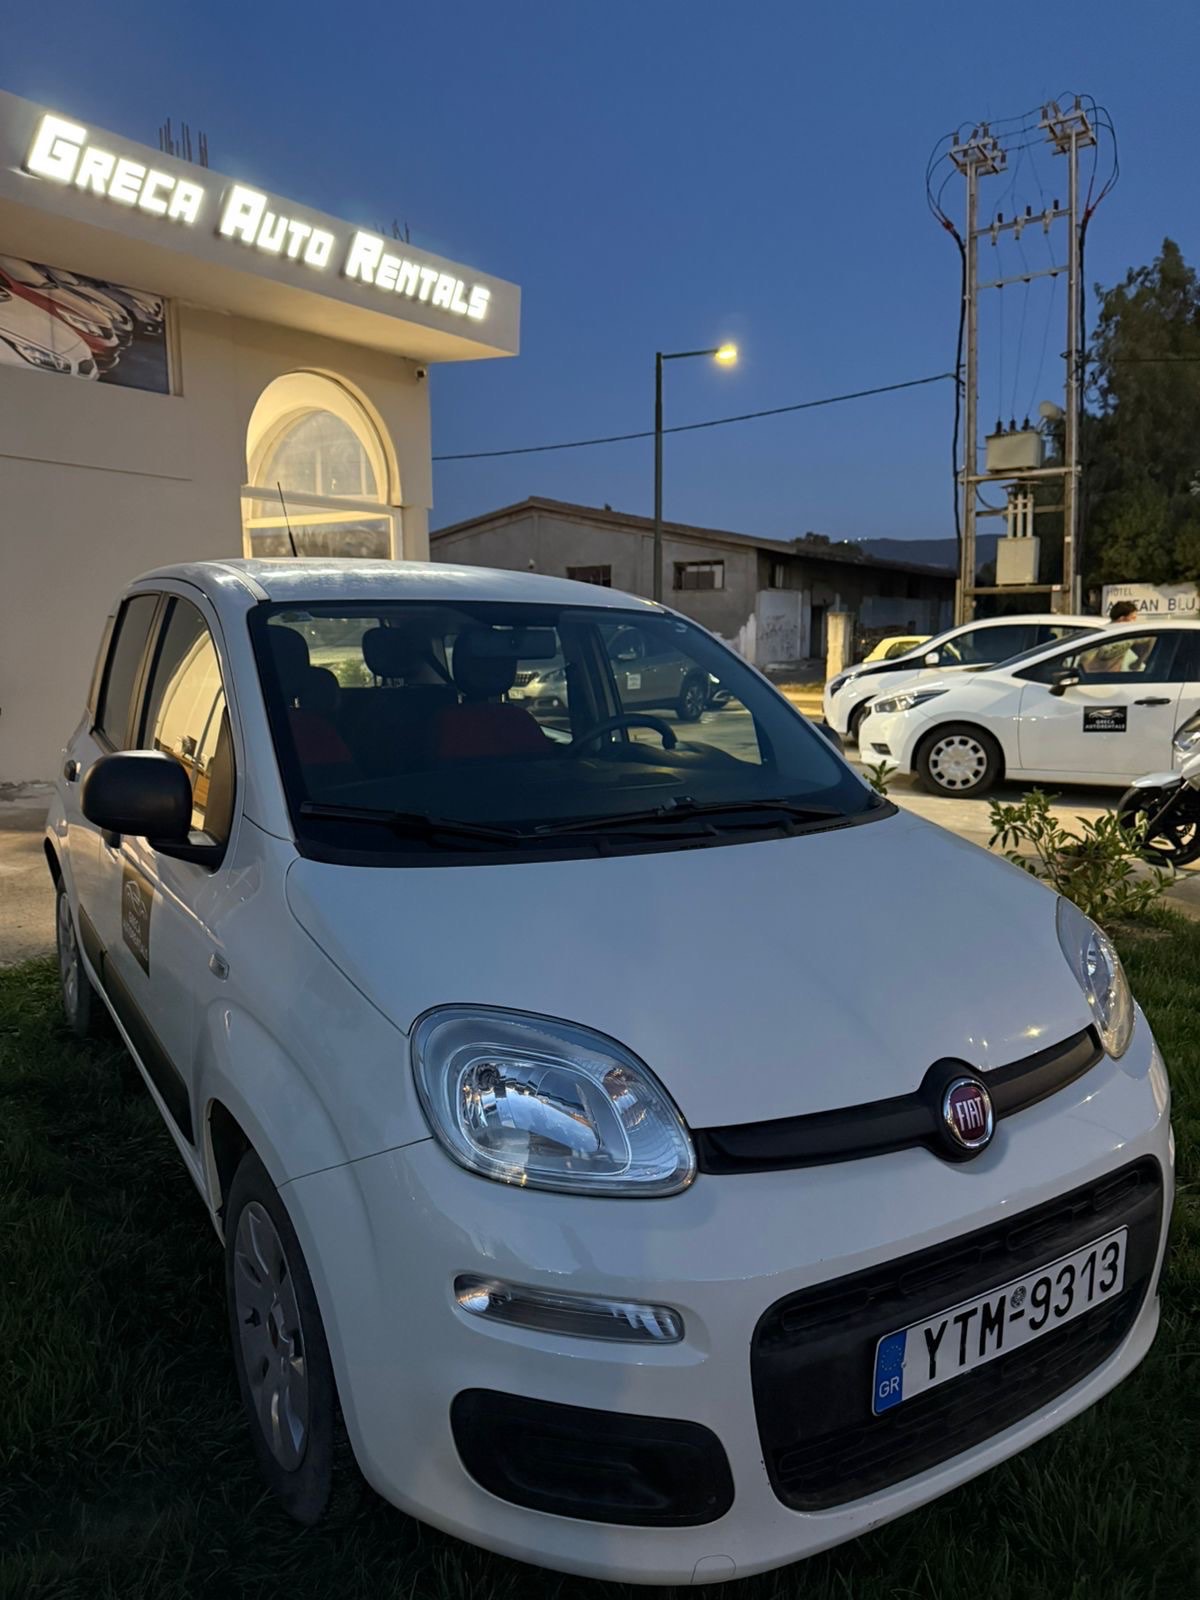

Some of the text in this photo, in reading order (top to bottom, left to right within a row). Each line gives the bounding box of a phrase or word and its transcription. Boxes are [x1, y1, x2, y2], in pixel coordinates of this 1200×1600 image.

[27, 111, 492, 321] GRECA AUTO RENTALS
[1106, 587, 1132, 597] HOTEL
[1106, 599, 1159, 612] AEAN
[955, 1096, 984, 1131] FIAT
[923, 1241, 1120, 1380] YTM-9313
[879, 1376, 900, 1398] GR
